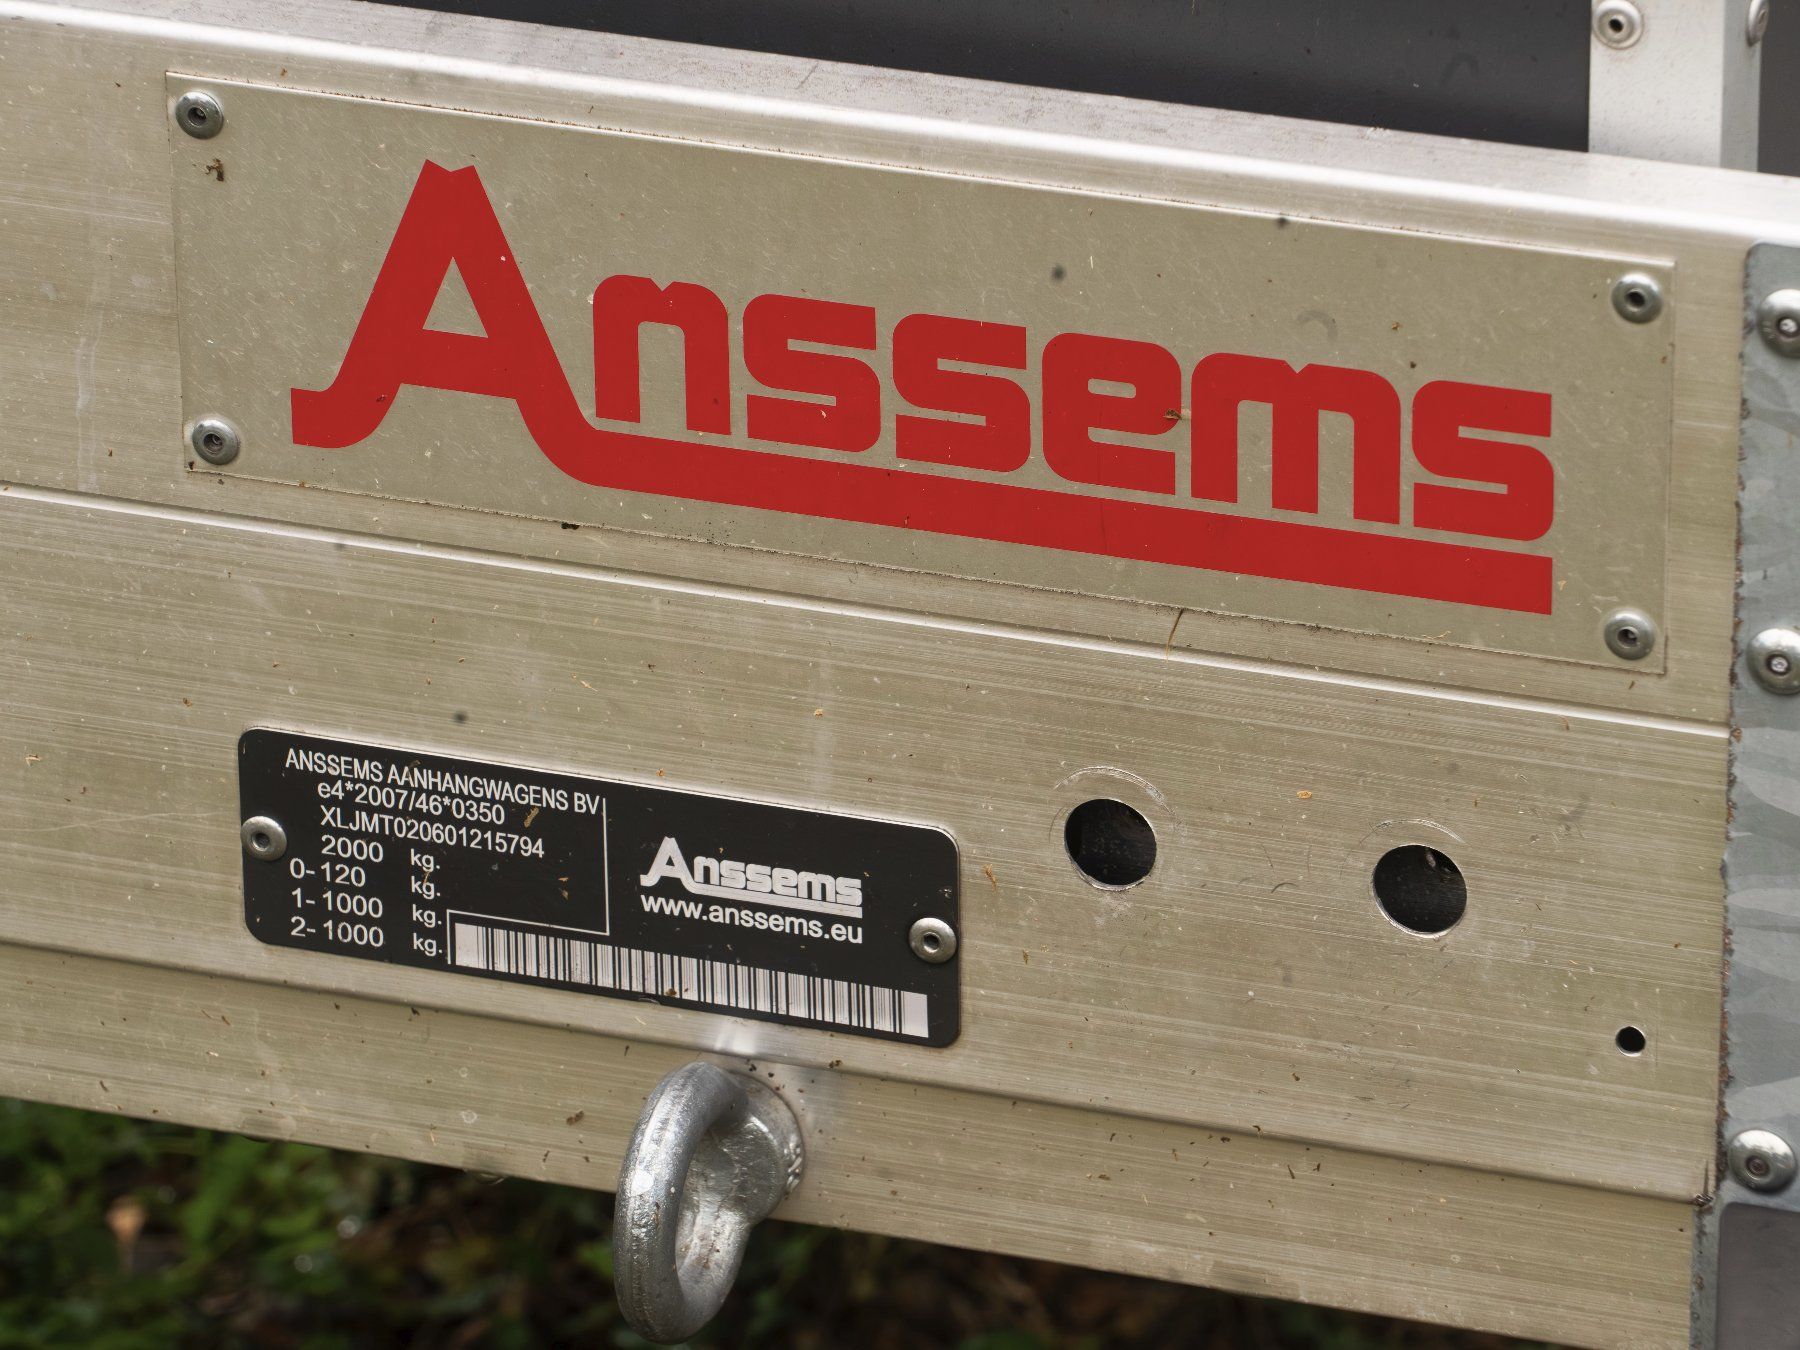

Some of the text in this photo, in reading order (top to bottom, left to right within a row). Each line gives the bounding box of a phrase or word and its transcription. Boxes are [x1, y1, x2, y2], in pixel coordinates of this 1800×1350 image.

[291, 160, 1553, 614] Anssems
[285, 748, 600, 815] ANSSEMS AANHANGWAGENS BV
[320, 805, 544, 858] XLJMT020601215794
[321, 835, 440, 873] 2000 kg.
[411, 876, 441, 900] kg.
[640, 836, 862, 919] Anssems
[412, 904, 442, 928] kg.
[640, 894, 862, 944] www.anssems.eu
[413, 933, 442, 957] kg.
